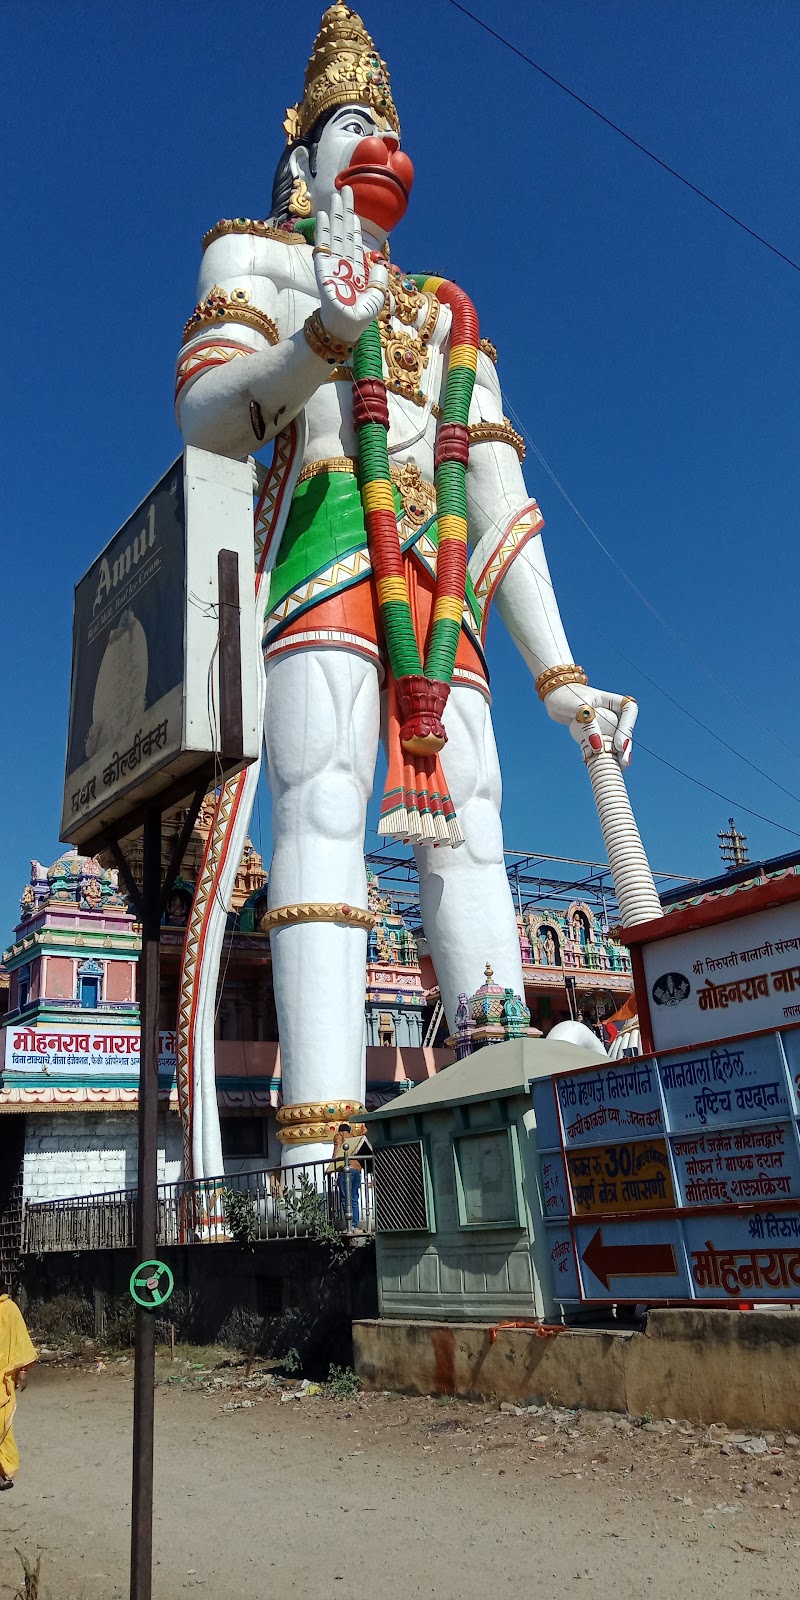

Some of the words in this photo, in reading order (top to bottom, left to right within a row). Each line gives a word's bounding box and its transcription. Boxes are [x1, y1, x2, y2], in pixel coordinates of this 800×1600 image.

[92, 503, 156, 616] Amul
[692, 960, 704, 975] श्री
[706, 951, 738, 973] तिरुपती
[739, 941, 774, 963] बालाजी
[774, 937, 800, 955] संस्था
[696, 974, 770, 1011] मोहनराव
[13, 1027, 91, 1054] मोहनराव
[165, 1031, 177, 1055] ने
[660, 1058, 709, 1090] मानवाला
[674, 1140, 698, 1156] जपान
[685, 1156, 714, 1176] मोफत
[715, 1153, 722, 1172] ते
[724, 1154, 753, 1172] माफक
[755, 1151, 784, 1170] दरात
[621, 1171, 667, 1202] तपासणी
[748, 1213, 764, 1239] श्री
